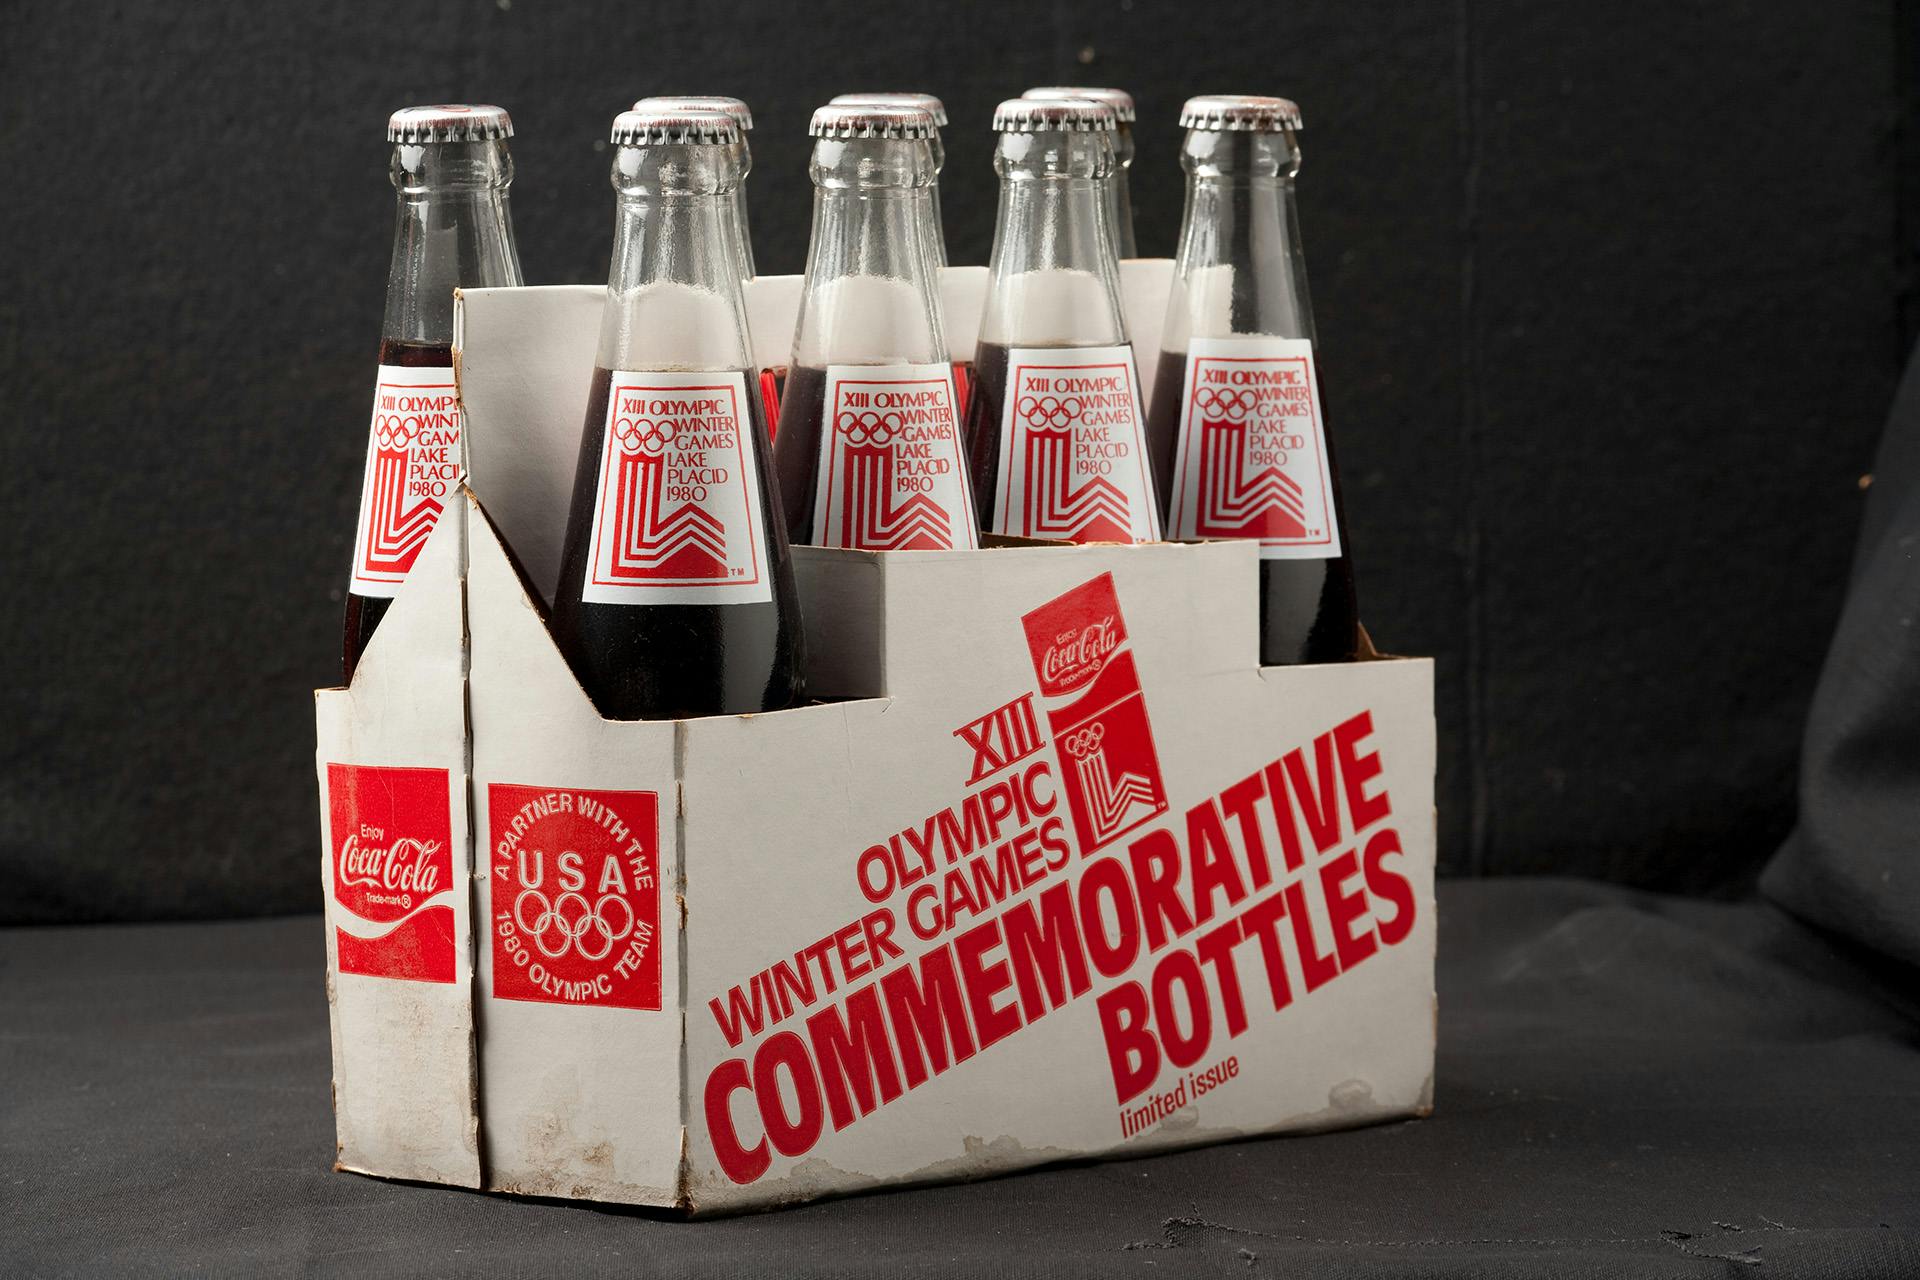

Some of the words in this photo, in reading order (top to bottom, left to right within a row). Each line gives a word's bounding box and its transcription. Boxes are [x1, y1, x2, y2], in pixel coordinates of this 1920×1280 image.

[1025, 377, 1049, 393] XIII
[1054, 377, 1123, 393] OLYMPIC
[1203, 369, 1228, 384] XIII
[1231, 370, 1301, 385] OLYMPIC
[844, 391, 869, 408] XIII
[874, 391, 944, 408] OLYMPIC
[1080, 394, 1130, 409] WINTER
[1255, 386, 1309, 401] WINTER
[381, 395, 395, 410] XIII
[399, 396, 458, 411] OLYMPI
[623, 398, 645, 415] XIII
[649, 399, 725, 416] OLYMPIC
[1257, 402, 1309, 418] GAMES
[418, 413, 459, 429] WINT
[900, 407, 951, 425] WINTER
[1081, 409, 1131, 426] GAMES
[674, 417, 734, 433] WINTER
[1250, 419, 1287, 434] LAKE
[418, 431, 459, 446] GAM
[674, 433, 734, 450] GAMES
[901, 425, 951, 442] GAMES
[1075, 428, 1110, 442] LAKE
[1076, 443, 1128, 458] PLACID
[1250, 435, 1304, 450] PLACID
[411, 448, 448, 463] LAKE
[896, 443, 932, 459] LAKE
[1249, 451, 1287, 466] 1980
[668, 452, 707, 468] LAKE
[897, 458, 950, 475] PLACID
[1076, 460, 1111, 475] 1980
[410, 464, 459, 479] PLACI
[667, 469, 728, 484] PLACID
[409, 481, 446, 497] 1980
[897, 477, 934, 492] 1980
[667, 486, 707, 502] 1980
[731, 568, 745, 577] TM
[1042, 615, 1116, 682] Coca-Cola
[952, 691, 1047, 787] XIII
[497, 793, 573, 860] PARTNER
[578, 796, 630, 843] WITH
[361, 824, 384, 841] Enjoy
[856, 760, 1058, 904] OLYMPIC
[340, 834, 442, 893] Coca-Cola
[625, 838, 655, 891] THE
[495, 864, 510, 881] A
[708, 907, 904, 1048] WINTER
[907, 816, 1071, 940] GAMES
[704, 709, 1392, 1185] COMMEMORATIVE
[496, 910, 530, 967] 1980
[529, 963, 613, 1001] OLYMPIC
[614, 919, 654, 980] TEAM
[1096, 828, 1417, 1106] BOTTLES
[1120, 1077, 1187, 1139] limited
[1188, 1055, 1239, 1099] issue
